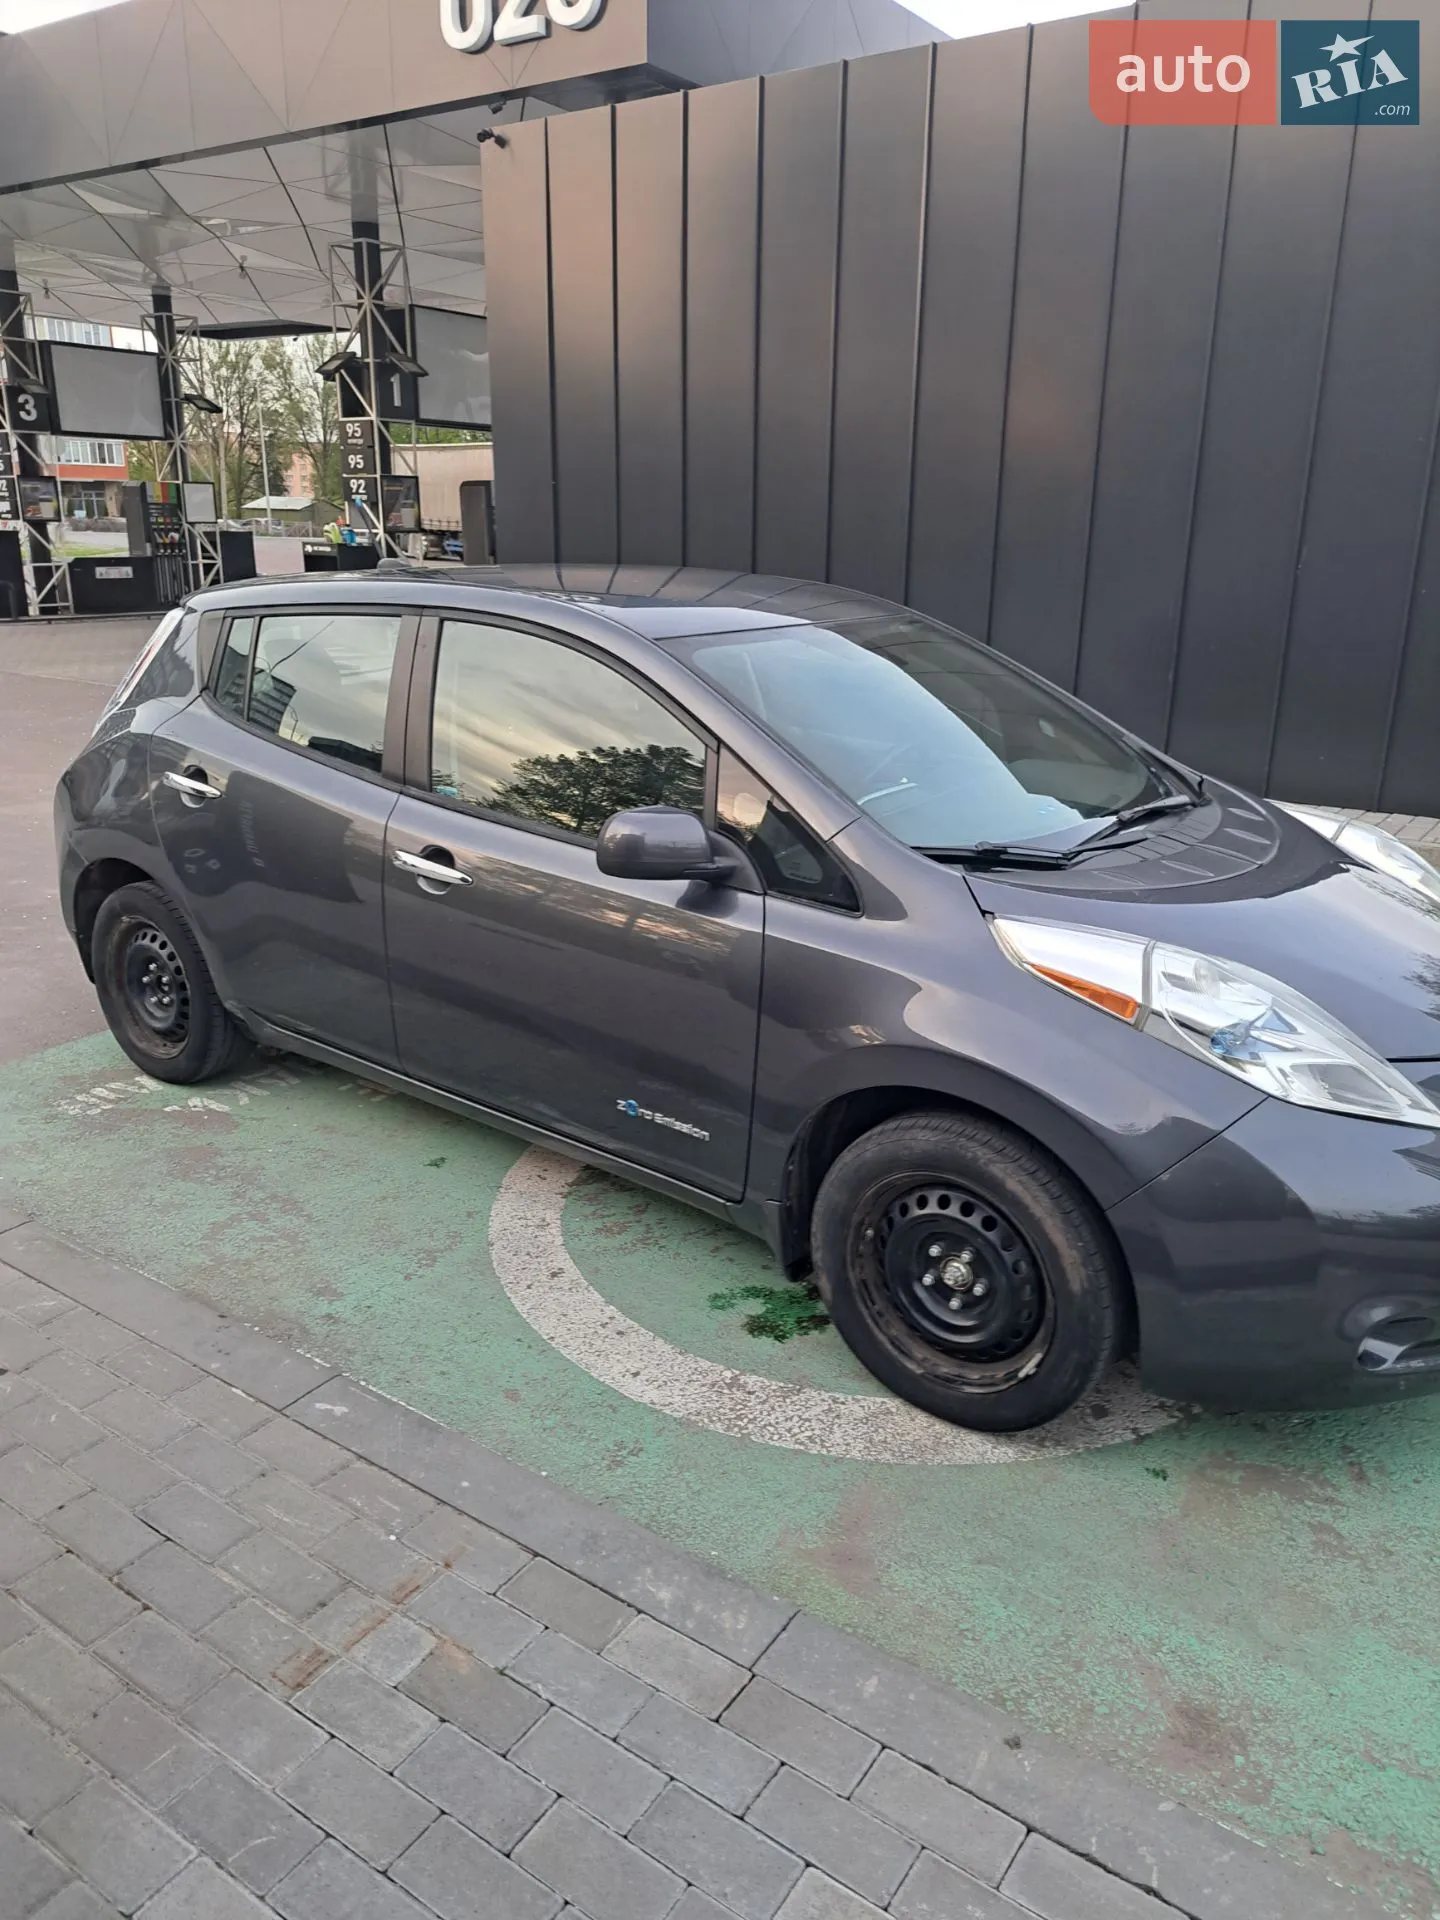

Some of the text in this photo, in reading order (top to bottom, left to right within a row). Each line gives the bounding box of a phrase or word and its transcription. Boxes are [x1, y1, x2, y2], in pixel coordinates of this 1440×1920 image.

[390, 373, 402, 407] 1
[17, 393, 38, 422] 3
[346, 423, 362, 437] 95
[348, 454, 364, 469] 95
[349, 479, 367, 494] 92
